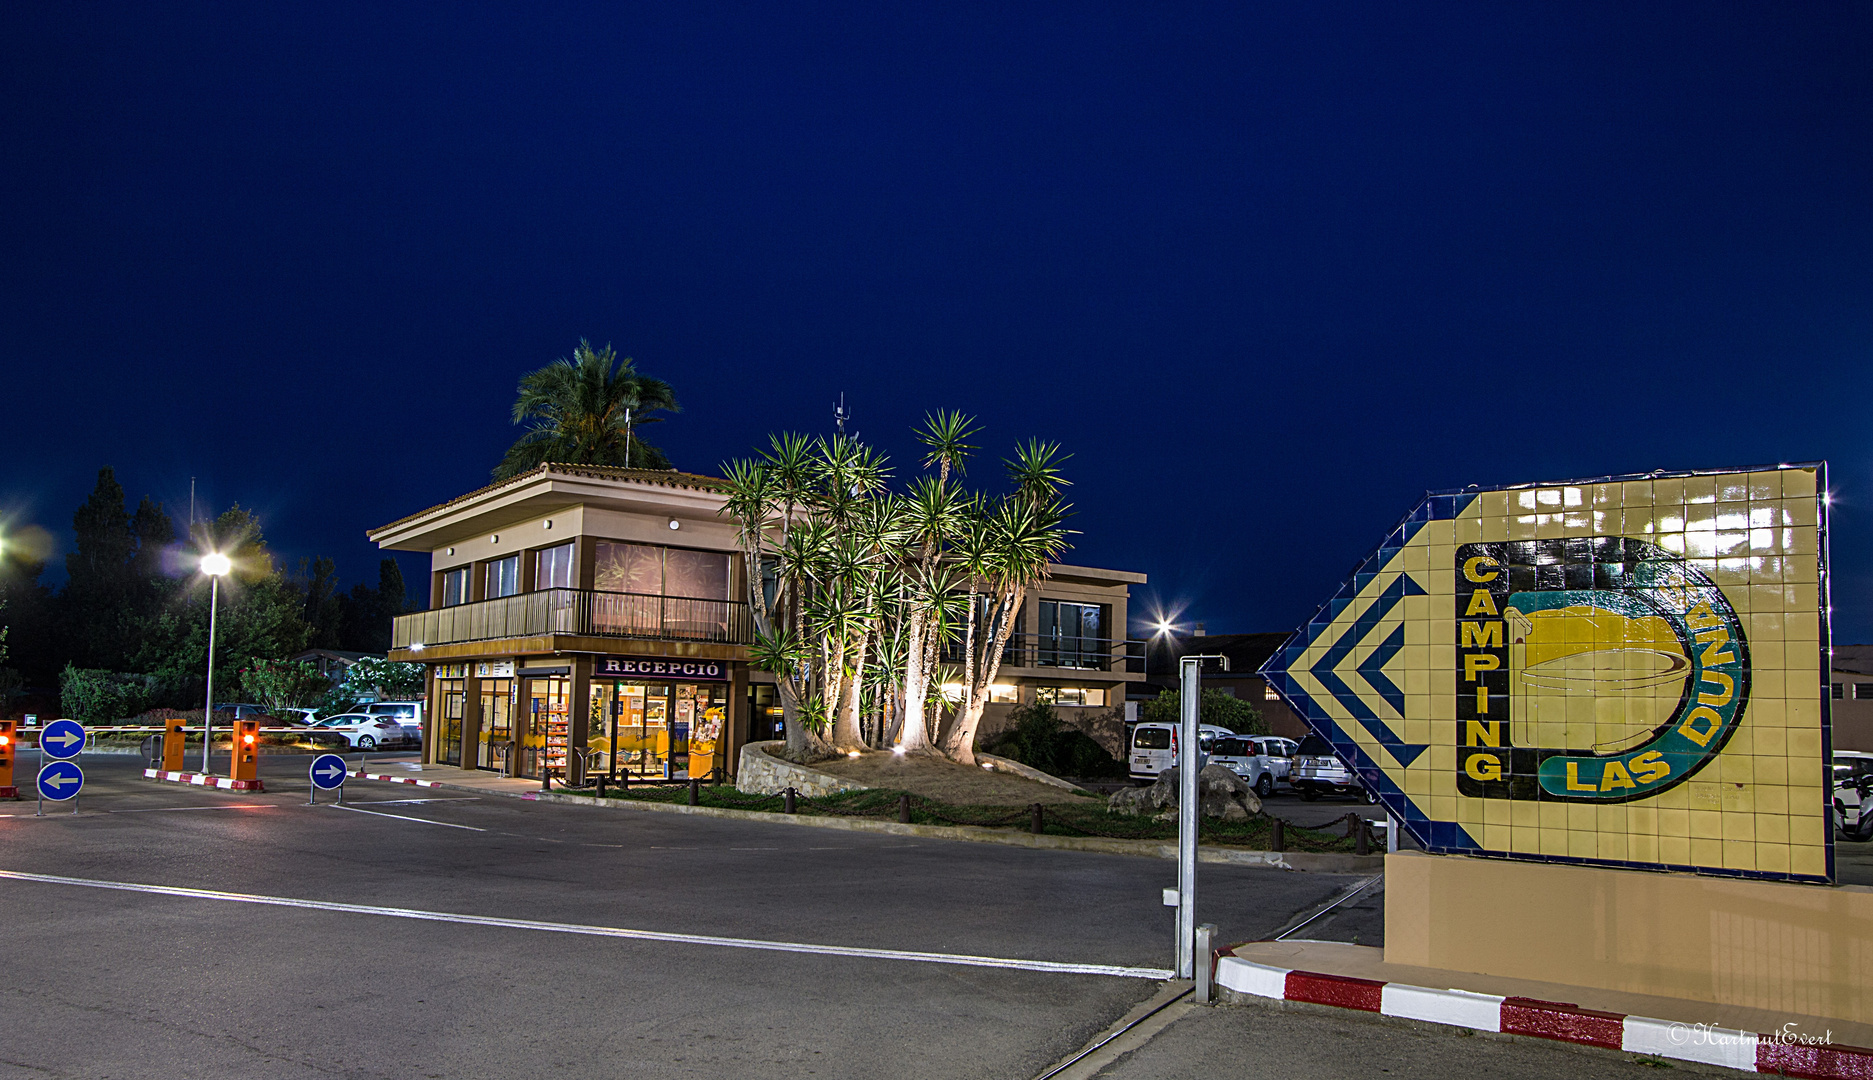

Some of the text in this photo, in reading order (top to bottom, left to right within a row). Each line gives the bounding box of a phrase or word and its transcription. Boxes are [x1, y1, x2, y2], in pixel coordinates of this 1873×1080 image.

[606, 661, 719, 676] RECEPCIÓ
[1462, 556, 1503, 782] CAMPING
[1566, 750, 1670, 792] LAS
[1659, 574, 1735, 748] DUNAS
